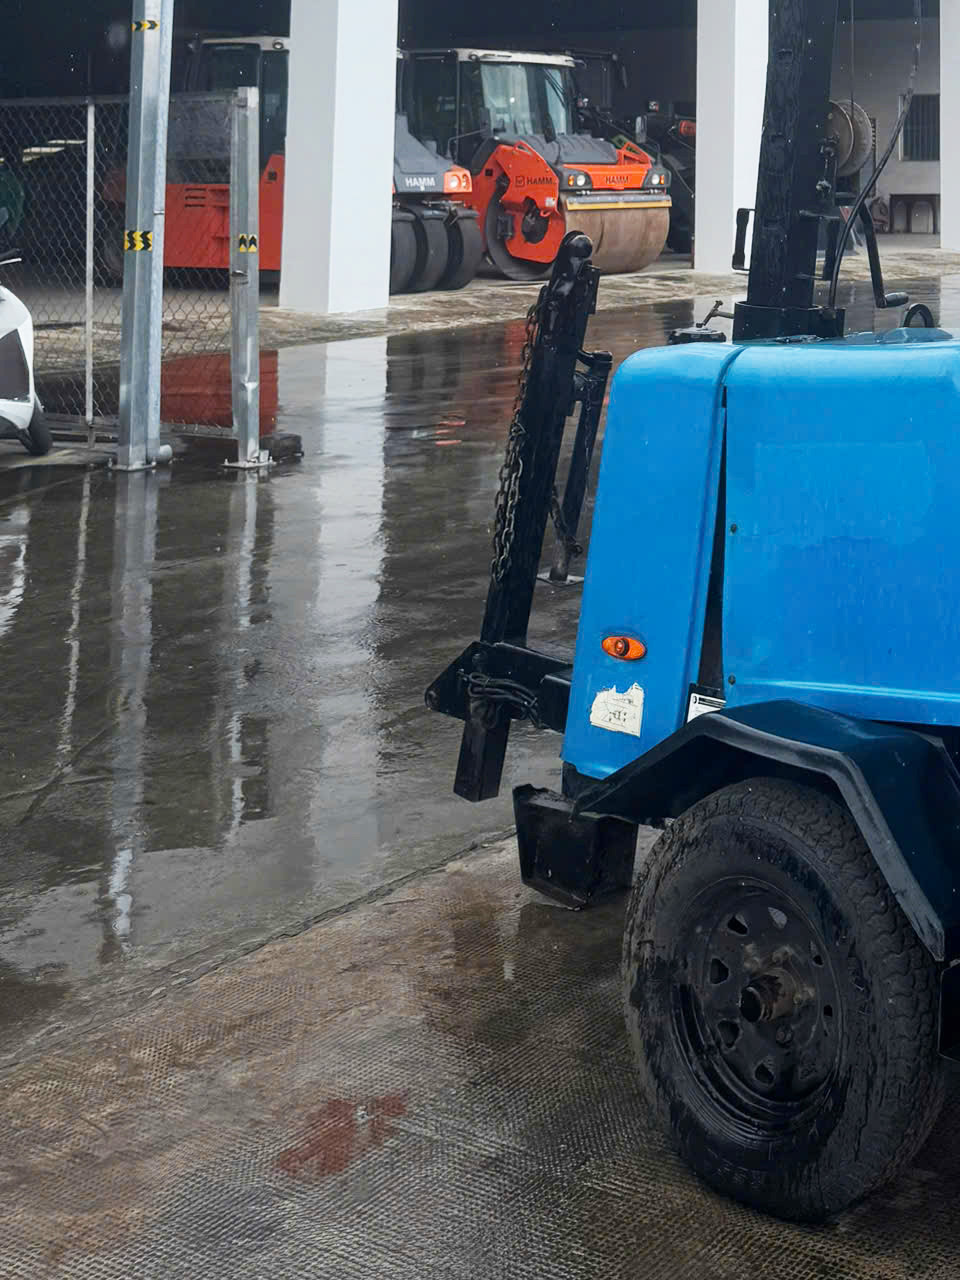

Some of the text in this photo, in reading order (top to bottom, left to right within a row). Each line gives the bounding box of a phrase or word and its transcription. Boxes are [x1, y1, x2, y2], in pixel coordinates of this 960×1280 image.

[404, 176, 436, 187] HAMM
[526, 176, 556, 186] HAMM
[605, 174, 630, 185] HAMM
